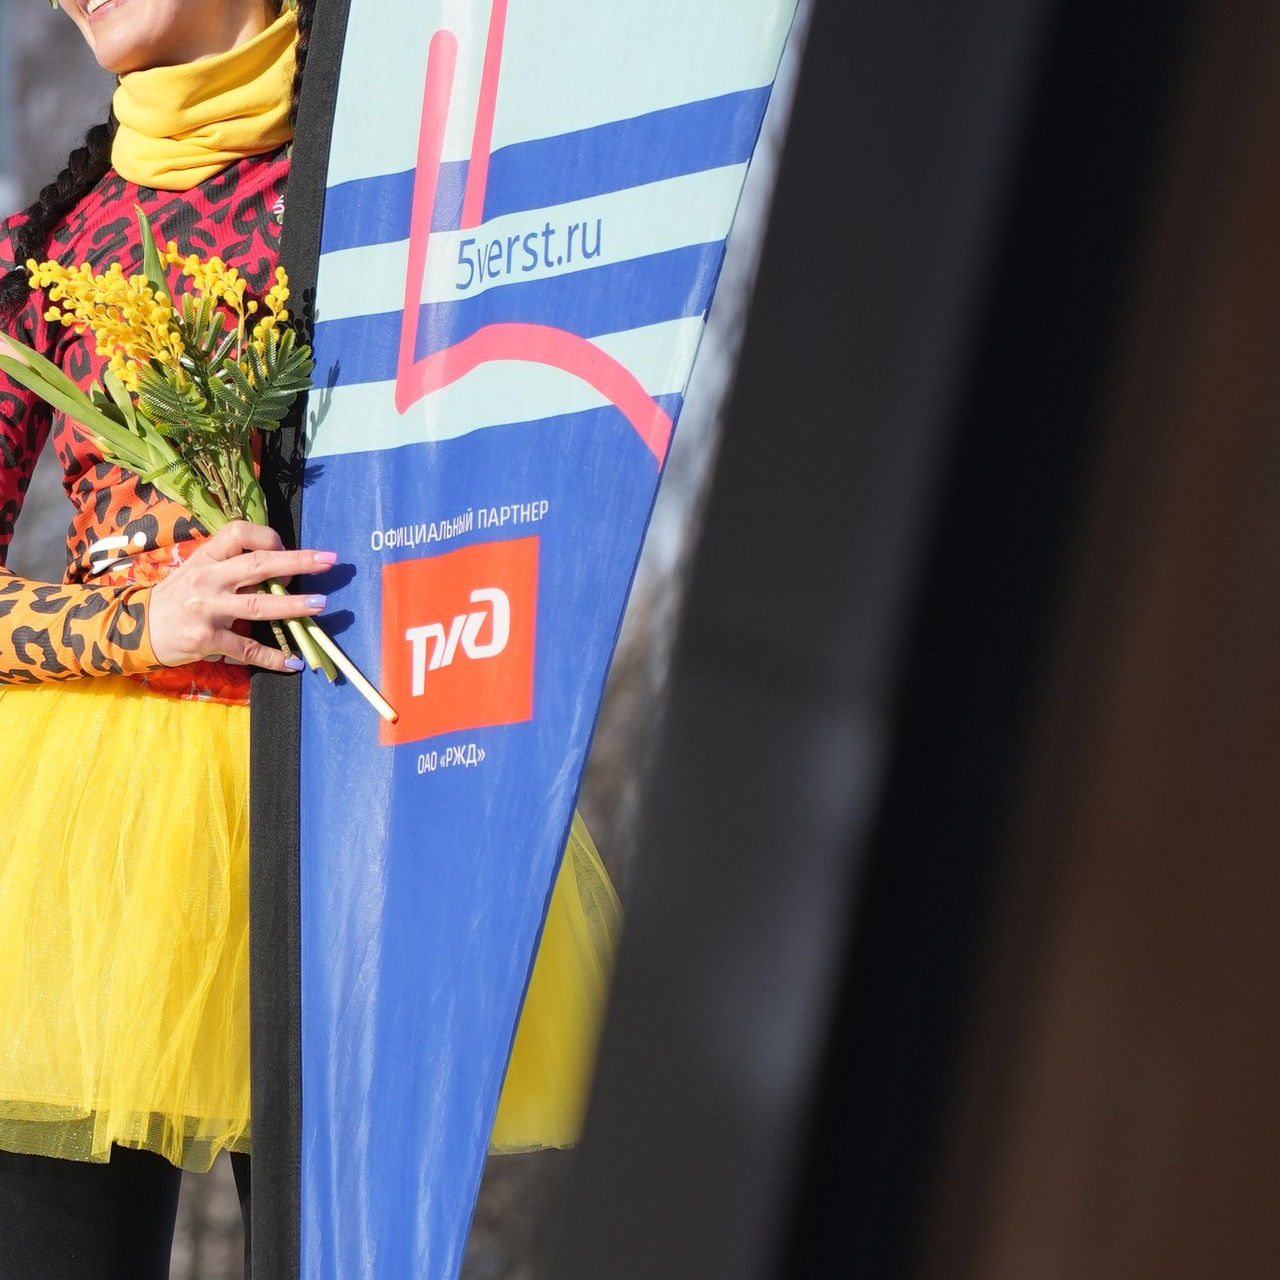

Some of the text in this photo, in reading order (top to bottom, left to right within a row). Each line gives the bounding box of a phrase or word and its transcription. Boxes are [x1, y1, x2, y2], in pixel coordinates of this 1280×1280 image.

[455, 218, 602, 290] 5verst.ru
[371, 500, 549, 551] ОФИЦИАЛЬНЫЙ ПАРТНЕР
[417, 751, 438, 775] ОАО
